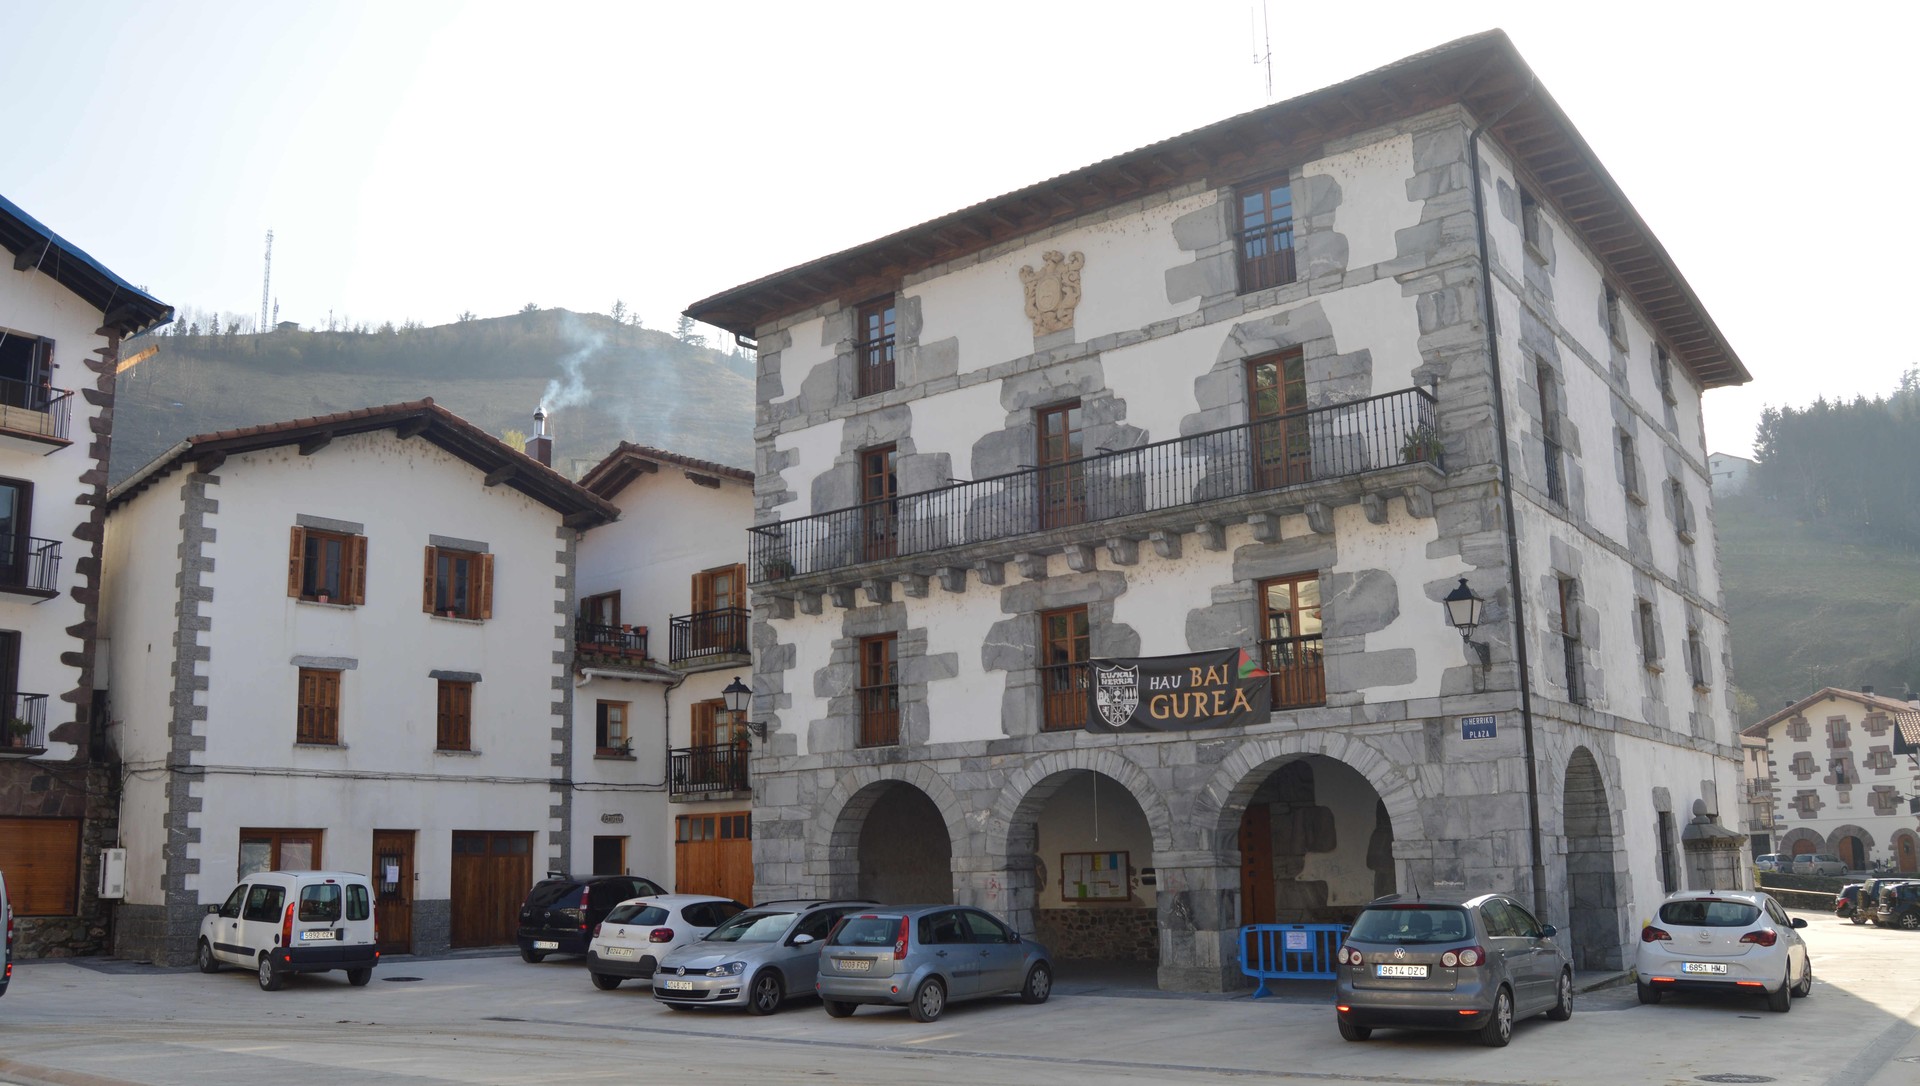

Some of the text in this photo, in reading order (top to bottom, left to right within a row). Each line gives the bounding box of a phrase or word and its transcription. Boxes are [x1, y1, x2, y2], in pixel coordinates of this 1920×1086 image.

[1100, 672, 1135, 680] EUSKAL
[1150, 664, 1229, 690] HAU BAI
[1150, 688, 1252, 720] GUREA
[1468, 716, 1494, 725] HERRIKO
[1469, 730, 1490, 739] PLAZA
[1382, 966, 1425, 976] 9614 DZC
[1688, 963, 1726, 973] 6851 HMJ
